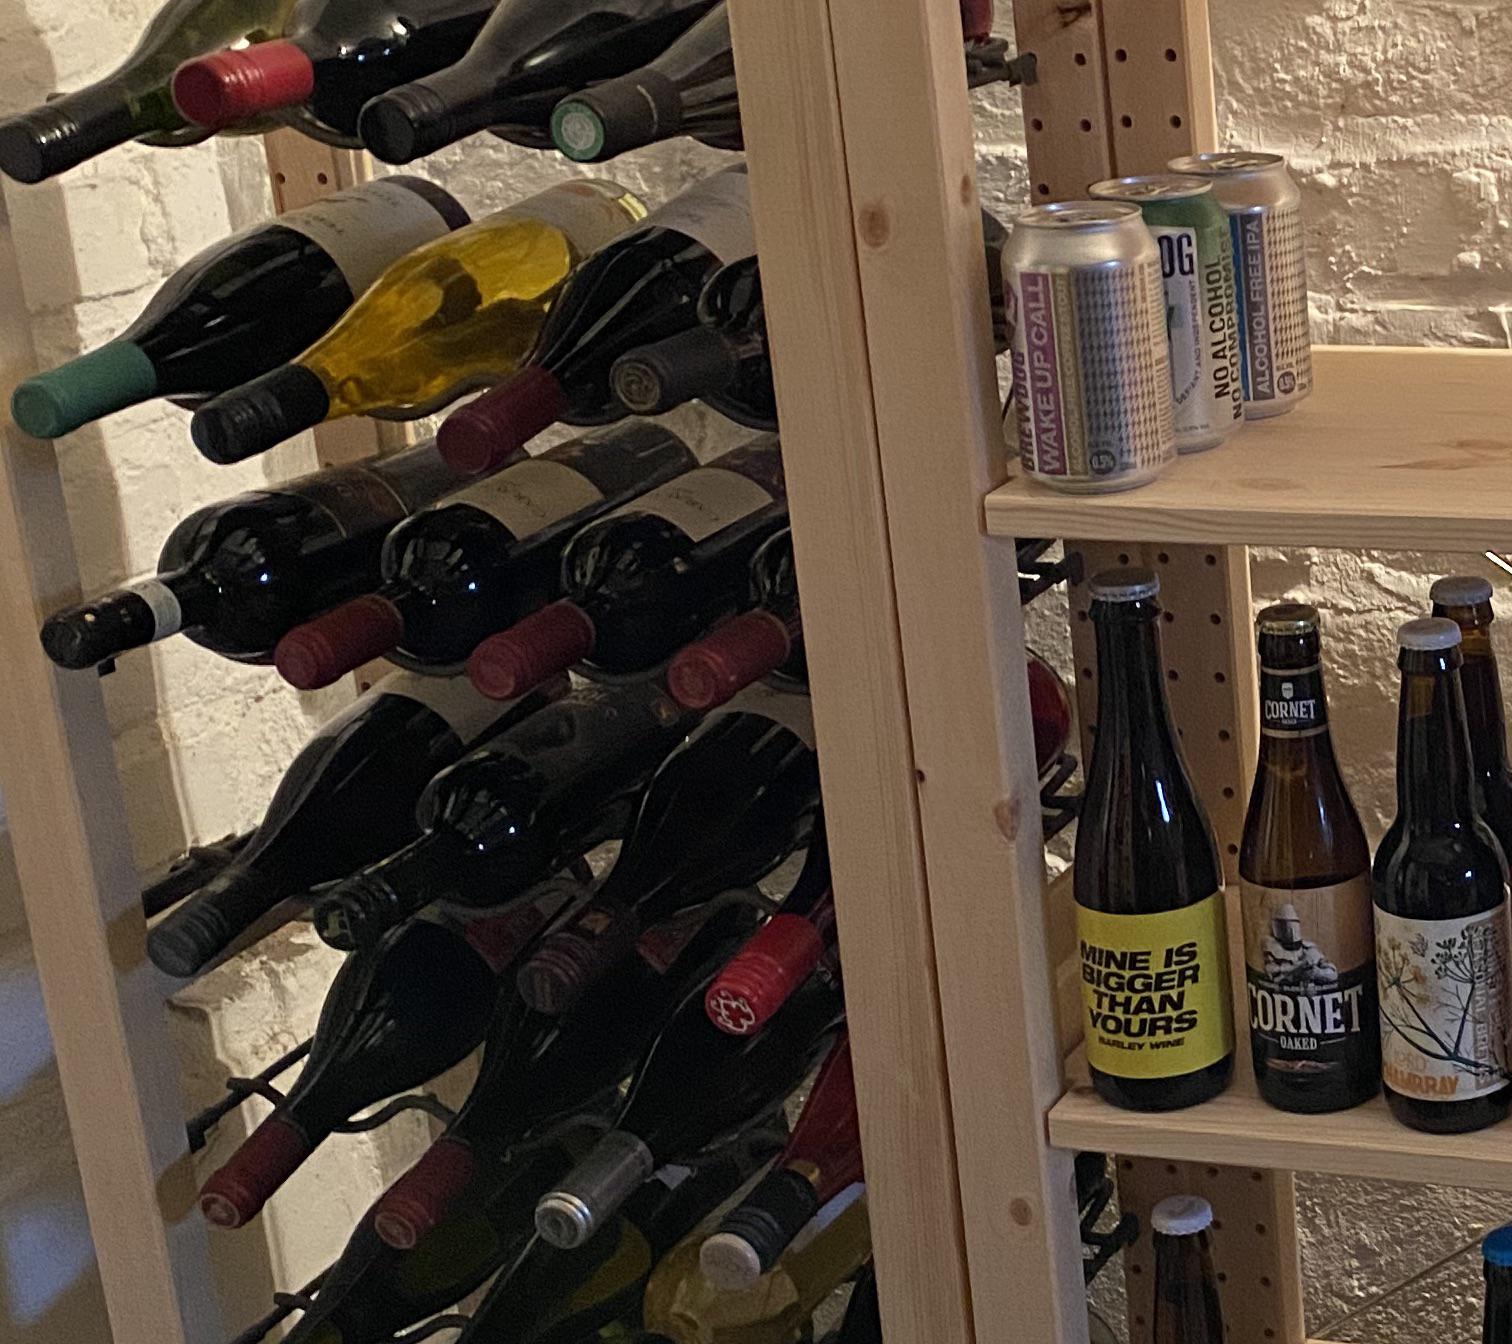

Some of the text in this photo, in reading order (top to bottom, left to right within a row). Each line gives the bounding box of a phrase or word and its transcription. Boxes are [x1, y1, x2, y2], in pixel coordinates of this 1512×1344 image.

[1245, 218, 1271, 394] ALCOHOL FREE IPA
[1204, 256, 1231, 399] NO ALCOHOL
[1031, 276, 1062, 473] WAKE UP CALL
[1232, 390, 1244, 420] NO
[1264, 699, 1316, 720] CORNET
[1081, 939, 1198, 971] MINE IS
[1082, 962, 1200, 994] BIGGER
[1093, 989, 1185, 1015] THAN
[1247, 982, 1363, 1034] CORNET
[1088, 1006, 1198, 1037] YOURS
[1149, 1037, 1186, 1050] WINE
[1280, 1036, 1318, 1051] OAKED
